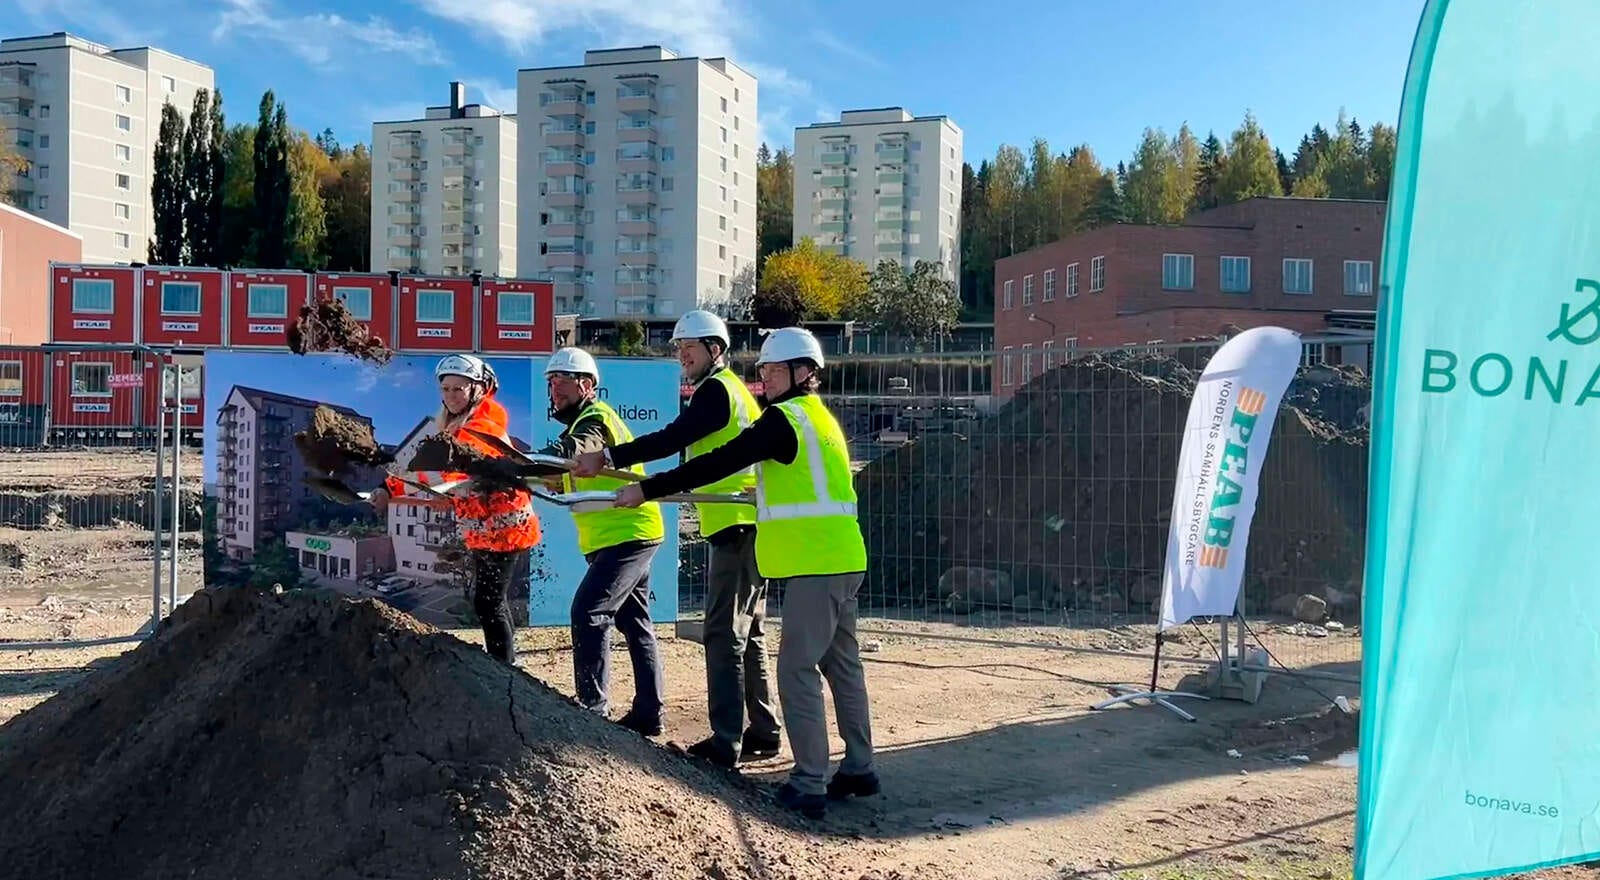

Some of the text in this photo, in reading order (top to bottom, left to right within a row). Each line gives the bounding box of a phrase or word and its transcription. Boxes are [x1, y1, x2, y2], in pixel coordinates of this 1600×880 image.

[1209, 381, 1232, 439] NORDENS
[1204, 406, 1258, 547] PEAB
[1464, 789, 1559, 818] bonava.se
